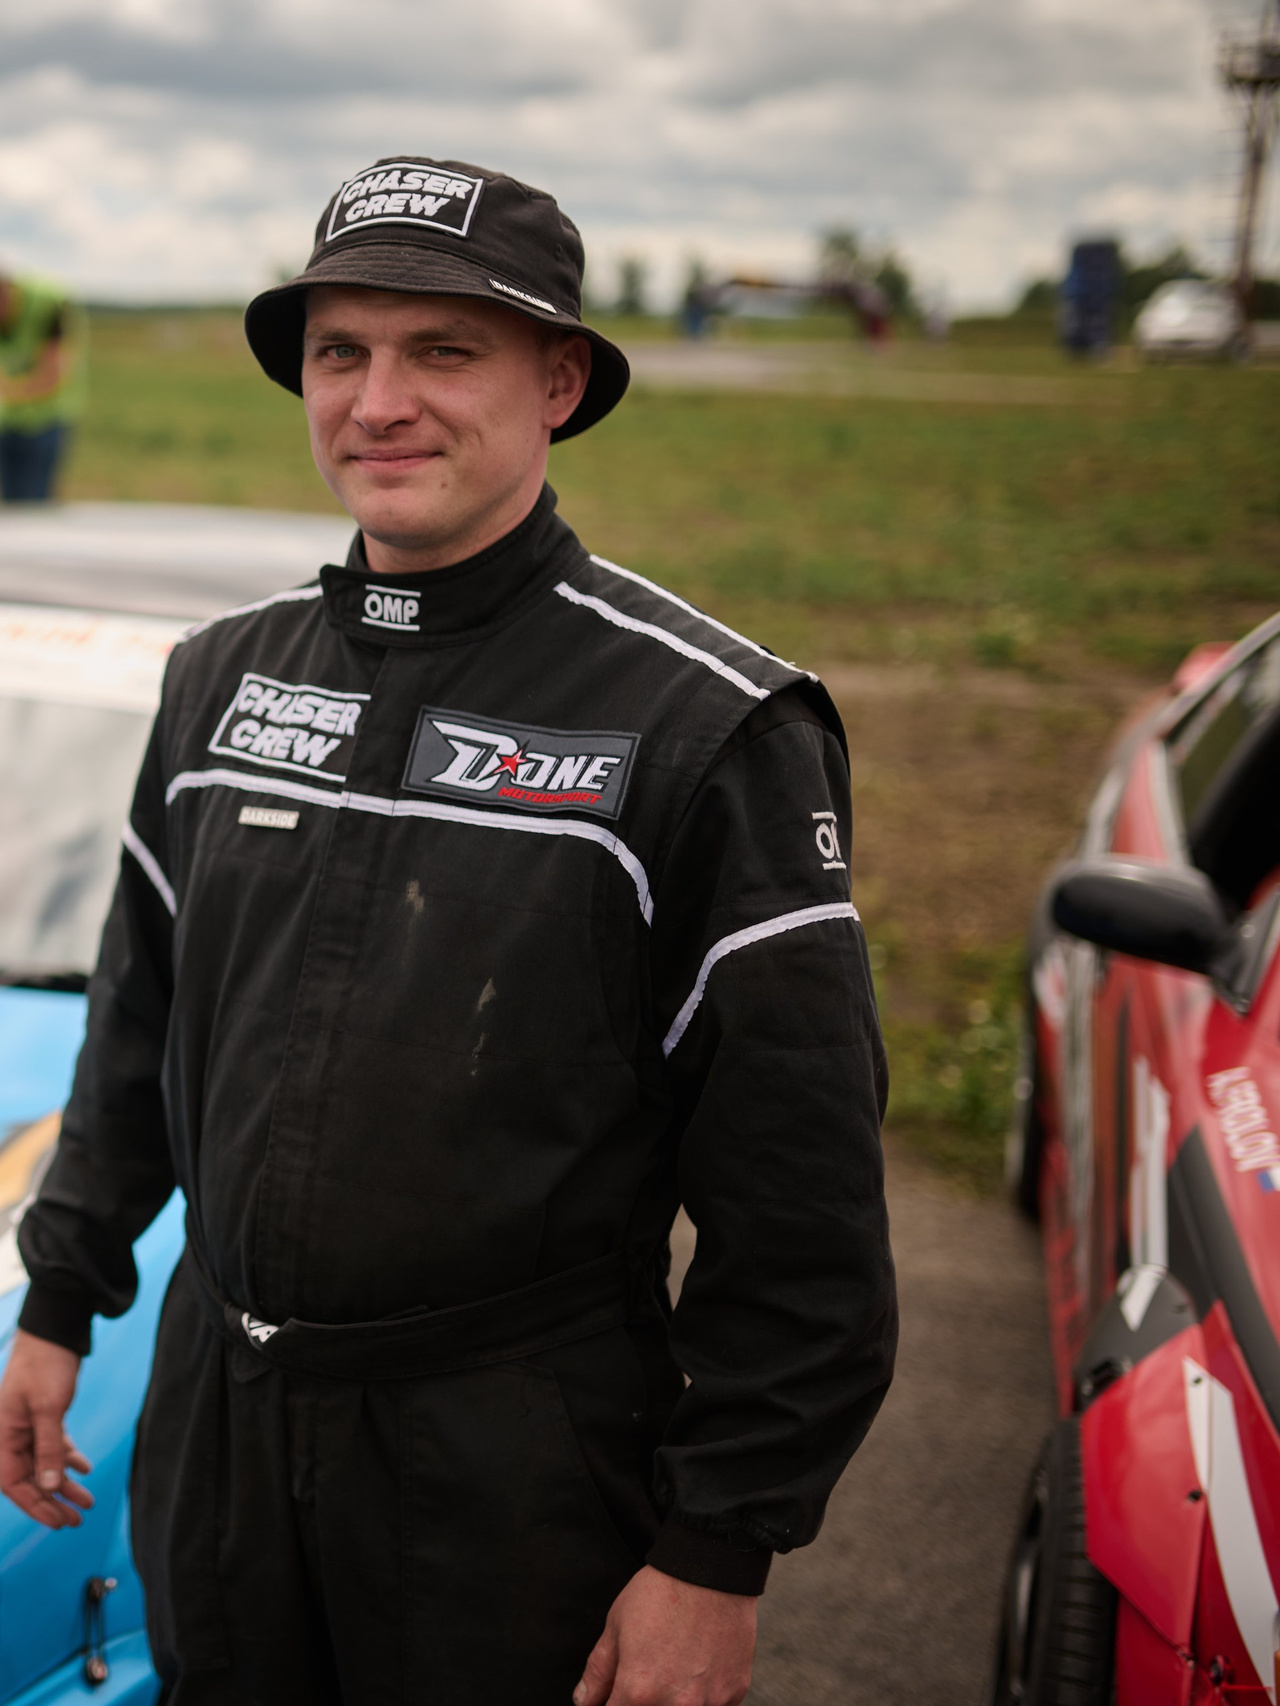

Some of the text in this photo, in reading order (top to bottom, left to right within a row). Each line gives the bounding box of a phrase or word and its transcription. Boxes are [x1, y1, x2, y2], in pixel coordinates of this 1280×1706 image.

[342, 170, 473, 204] CHASER
[344, 193, 451, 223] CREW
[364, 592, 419, 624] OMP
[236, 682, 362, 736] CHASER
[230, 718, 342, 767] CREW
[497, 786, 603, 805] MOTORSPORT
[239, 806, 299, 828] DARKSIDE
